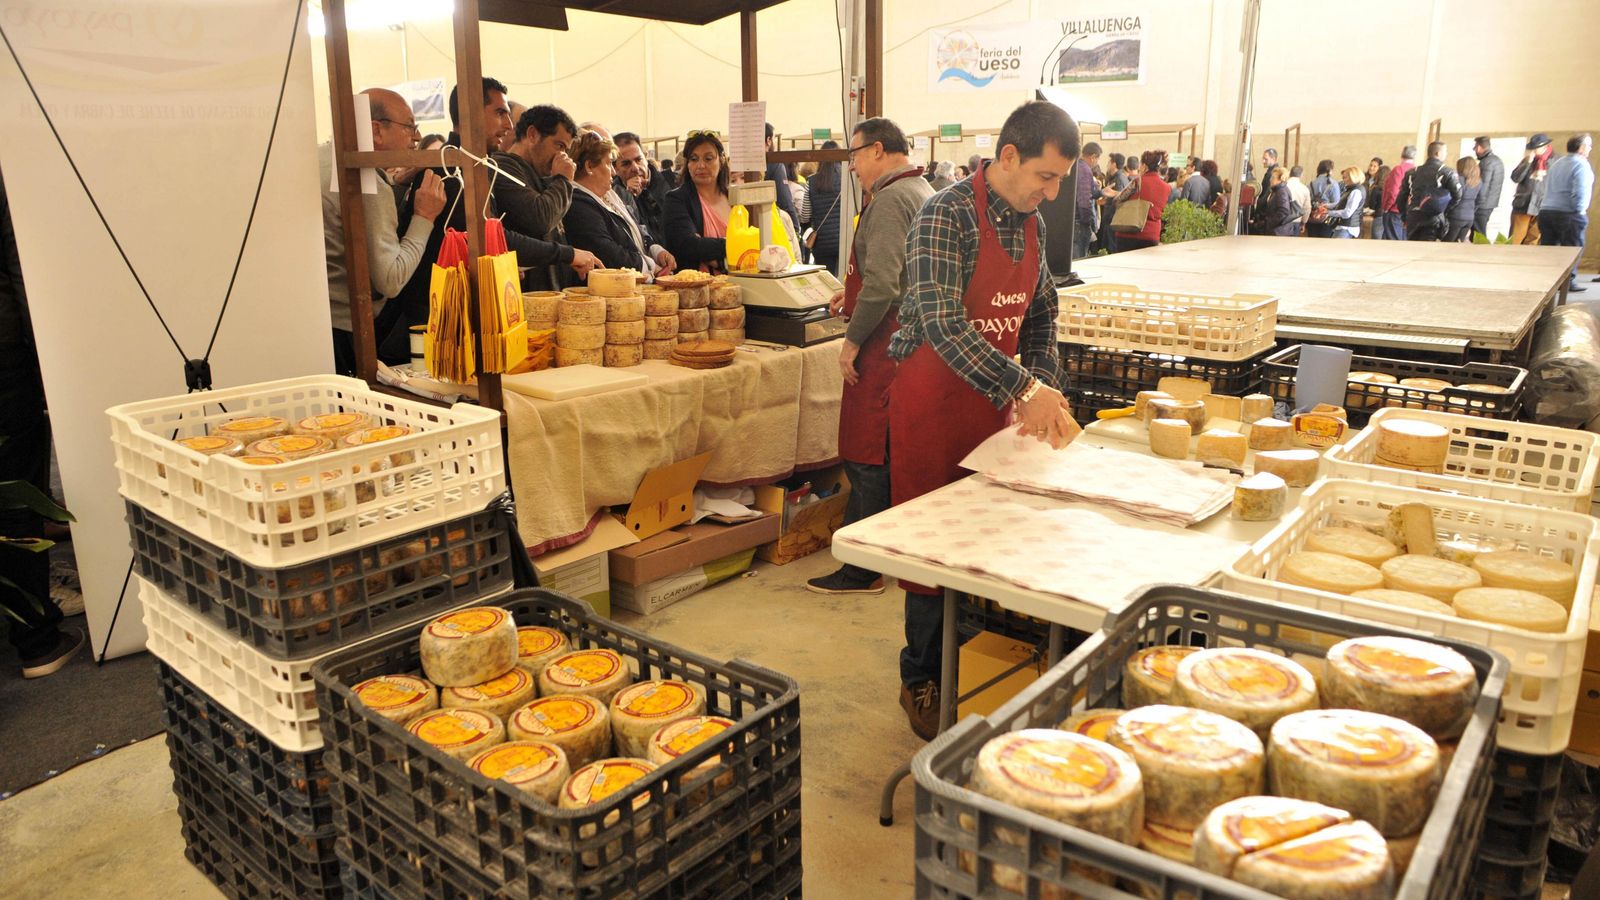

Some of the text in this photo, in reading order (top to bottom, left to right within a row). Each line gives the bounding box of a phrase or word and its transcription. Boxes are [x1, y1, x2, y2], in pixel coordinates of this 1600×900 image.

[1061, 16, 1141, 35] VILLALUENGA
[980, 45, 1022, 58] feria del
[991, 292, 1027, 308] Queso
